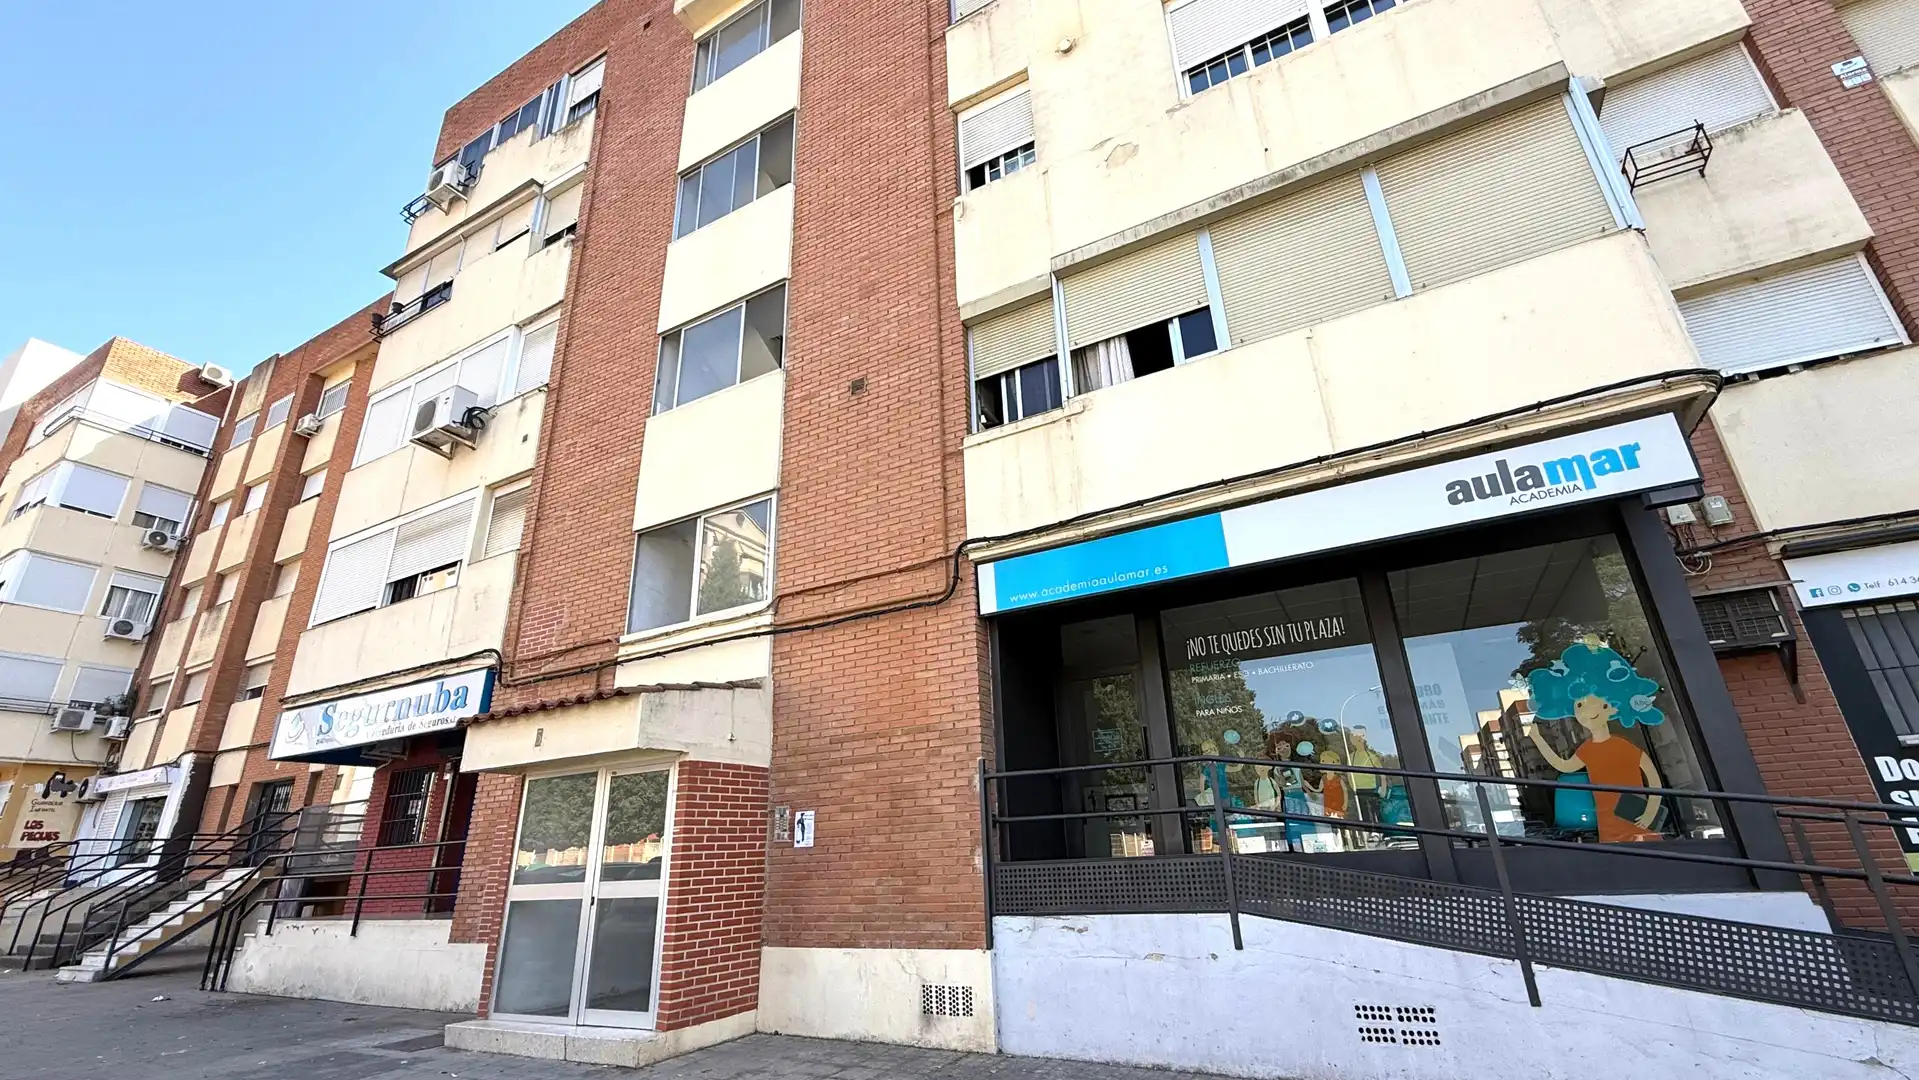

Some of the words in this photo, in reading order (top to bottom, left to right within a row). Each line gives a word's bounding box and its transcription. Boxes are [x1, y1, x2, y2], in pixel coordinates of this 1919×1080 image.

[1445, 442, 1641, 506] aulamar
[1509, 483, 1583, 506] ACADEMIA
[1009, 565, 1169, 603] www.academiaaulamar.es
[1888, 577, 1907, 587] 614
[1186, 636, 1206, 660] ¡NO
[1207, 634, 1221, 654] TE
[1221, 627, 1263, 655] QUEDES
[1264, 623, 1286, 647] SIN
[1286, 622, 1304, 643] TU
[1304, 616, 1346, 641] PLAZA!
[1189, 657, 1241, 674] REFUERZO
[1191, 673, 1226, 684] PRIMARIA
[1233, 670, 1250, 680] ESO
[1257, 661, 1314, 676] BACHILLERATO
[317, 681, 469, 738] Segurnuba
[1195, 707, 1215, 717] PARA
[1216, 705, 1243, 715] NIÑOS
[20, 831, 60, 841] PEQUES
[24, 820, 44, 829] LOS
